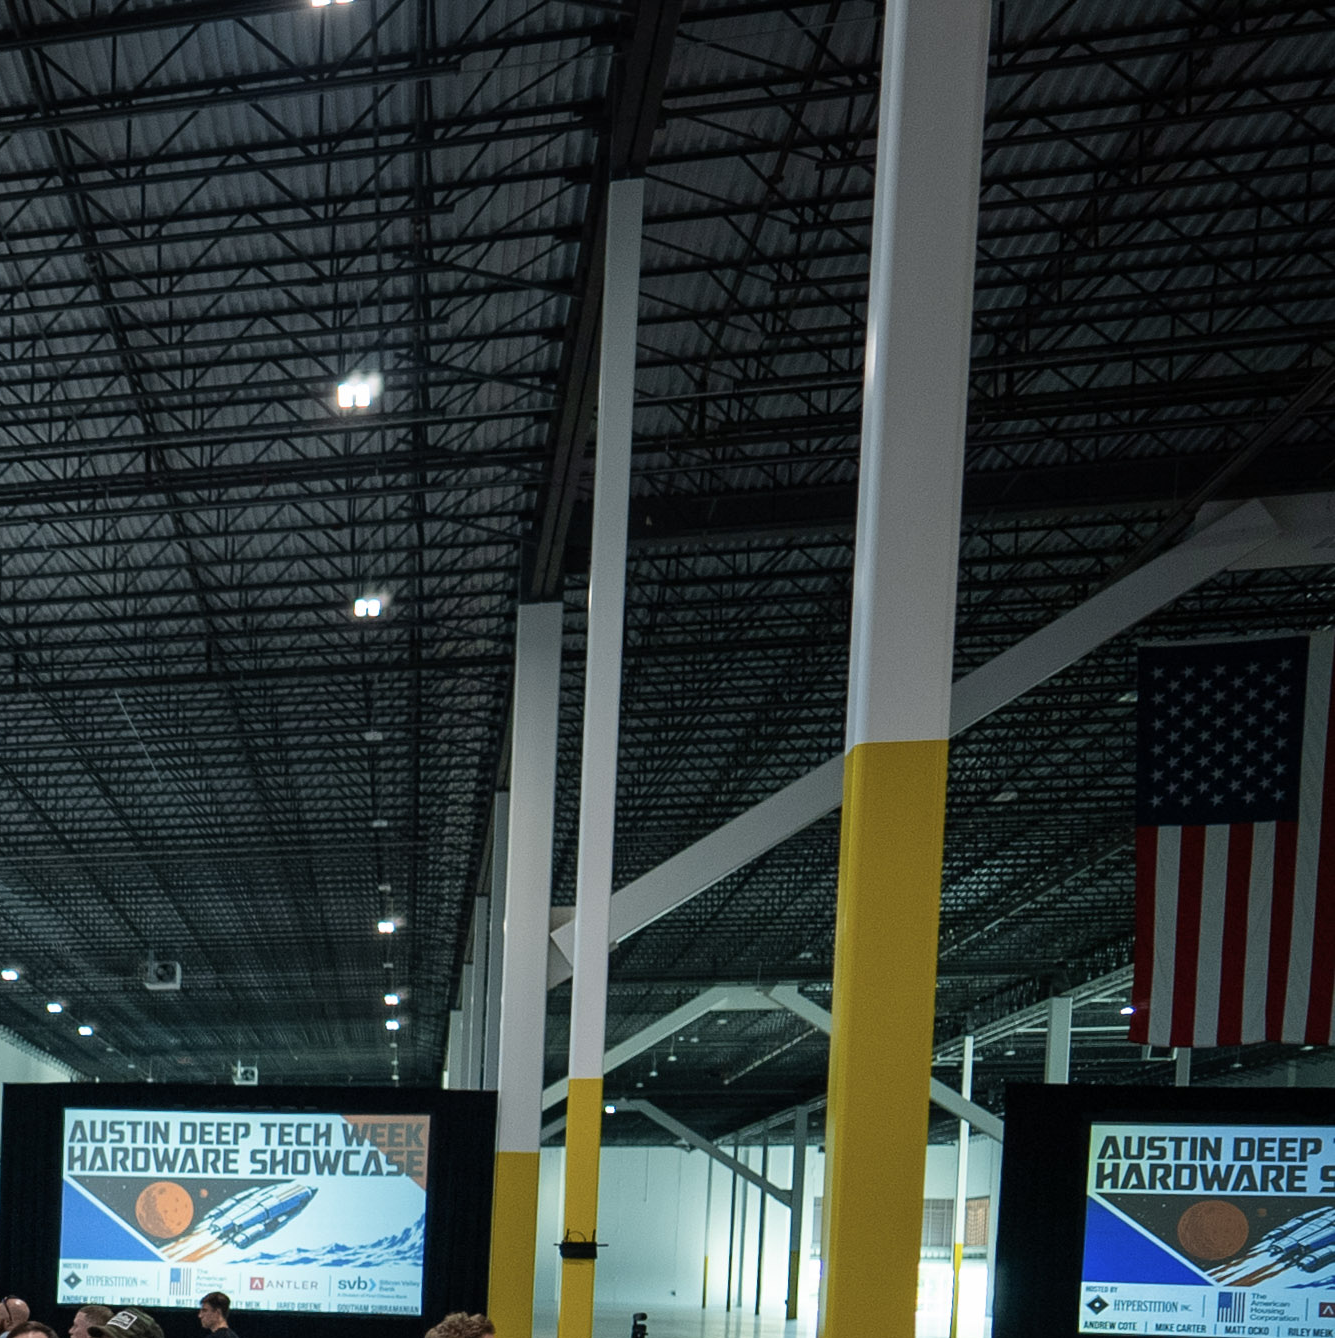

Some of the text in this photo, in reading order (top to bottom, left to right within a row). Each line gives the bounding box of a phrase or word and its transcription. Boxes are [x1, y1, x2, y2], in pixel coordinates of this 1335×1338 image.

[68, 1119, 426, 1148] AUSTIN DEEP TECH WEEK
[1097, 1135, 1323, 1162] AUSTIN DEEP
[67, 1145, 425, 1177] HARDWARE SHOWCASE
[1095, 1162, 1308, 1193] HARDWARE
[85, 1275, 138, 1288] HYPERSTITION
[266, 1279, 319, 1291] ANTLER
[337, 1275, 368, 1291] svb
[1113, 1299, 1179, 1313] HYPERSTITION
[1249, 1307, 1285, 1315] Housing
[1248, 1314, 1300, 1322] Corporation
[1083, 1320, 1138, 1331] ANDREW COTE
[1154, 1322, 1207, 1333] MIKE CARTER
[1224, 1325, 1247, 1335] MATT
[1312, 1328, 1334, 1338] MEIK
